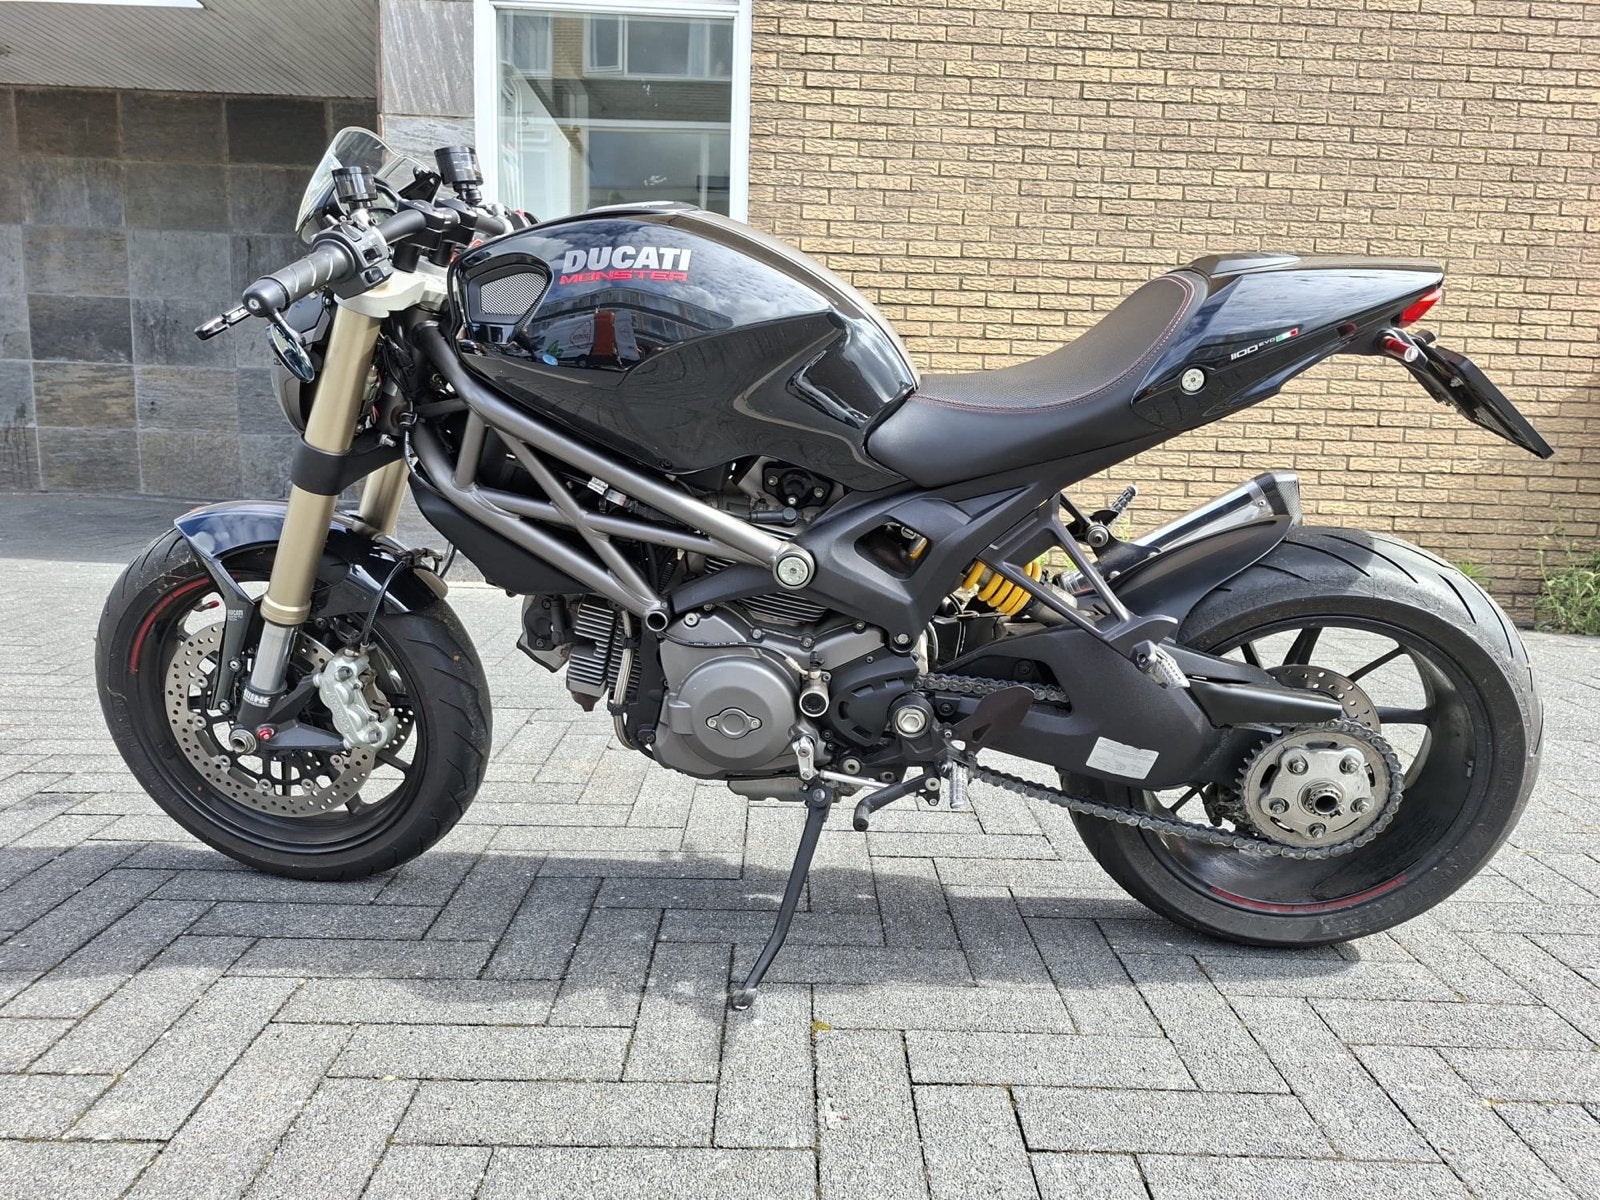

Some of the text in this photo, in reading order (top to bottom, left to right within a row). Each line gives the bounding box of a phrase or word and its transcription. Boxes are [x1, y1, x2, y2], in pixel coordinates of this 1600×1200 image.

[561, 245, 692, 274] DUCATI
[559, 270, 688, 285] MONSTER
[1230, 337, 1276, 361] 1100 EVO
